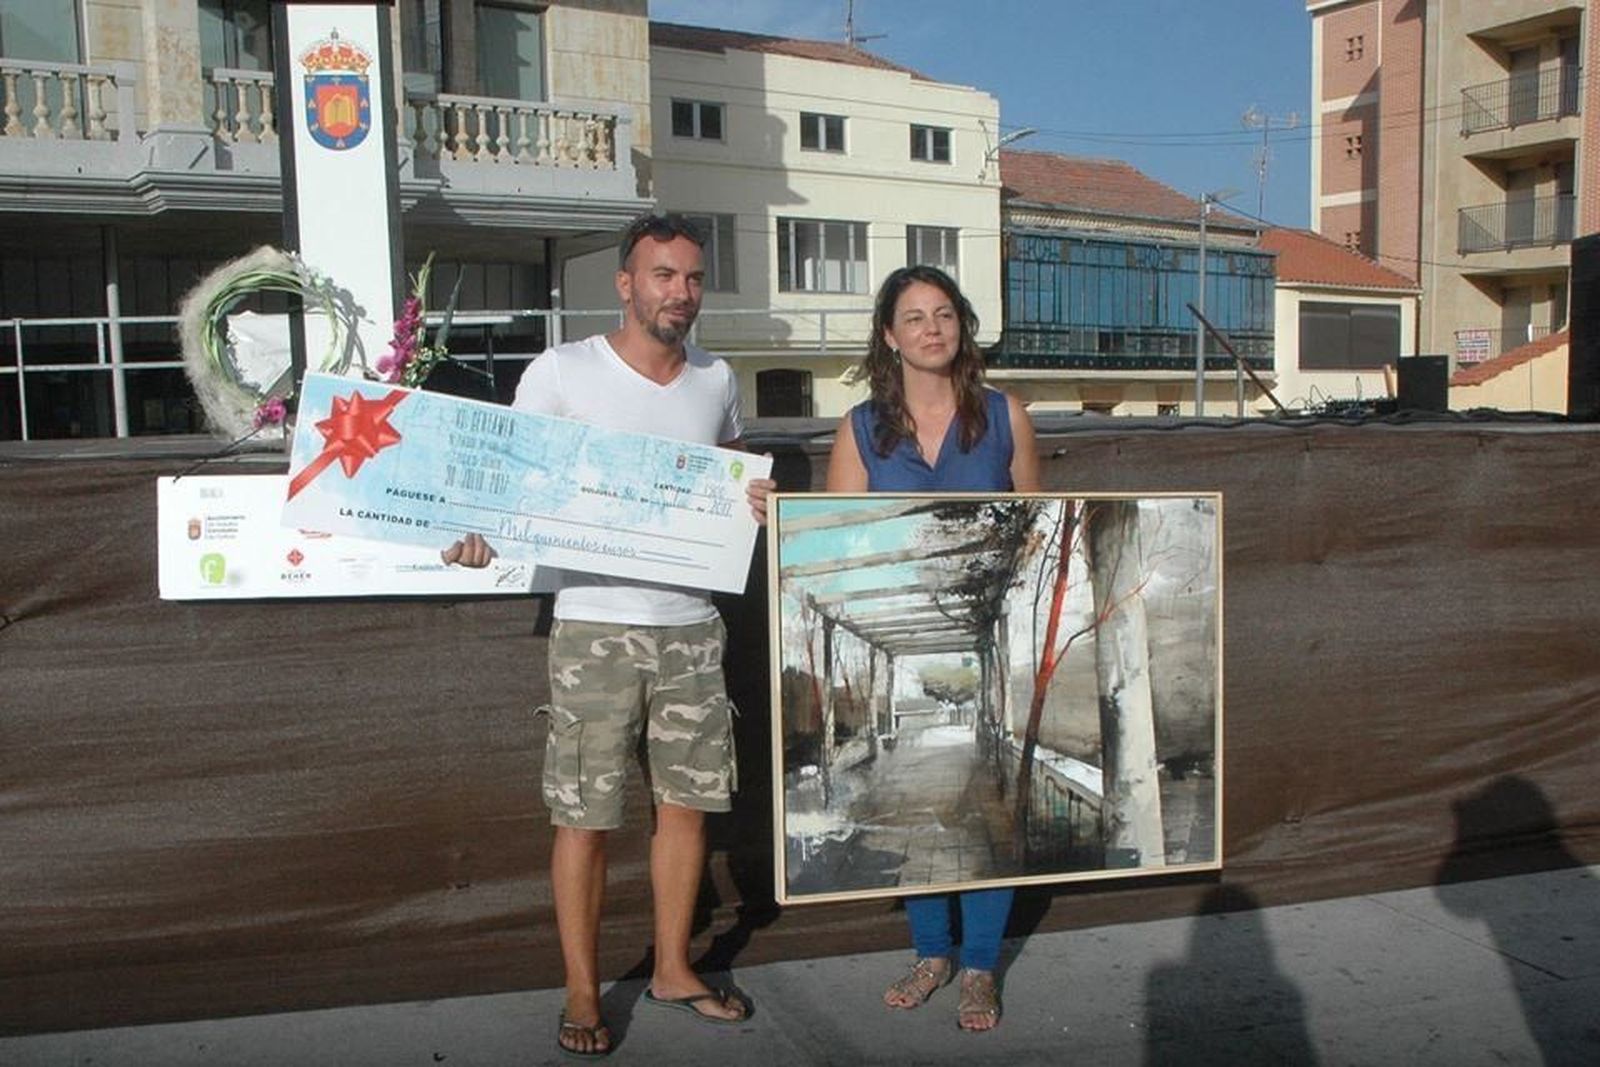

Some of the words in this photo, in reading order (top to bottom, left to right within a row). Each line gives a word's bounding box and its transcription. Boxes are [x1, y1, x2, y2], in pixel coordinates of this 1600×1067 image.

[386, 487, 435, 502] PÁGUESE
[438, 495, 447, 504] A
[339, 508, 353, 517] LA
[357, 510, 412, 526] CANTIDAD
[415, 518, 431, 528] DE
